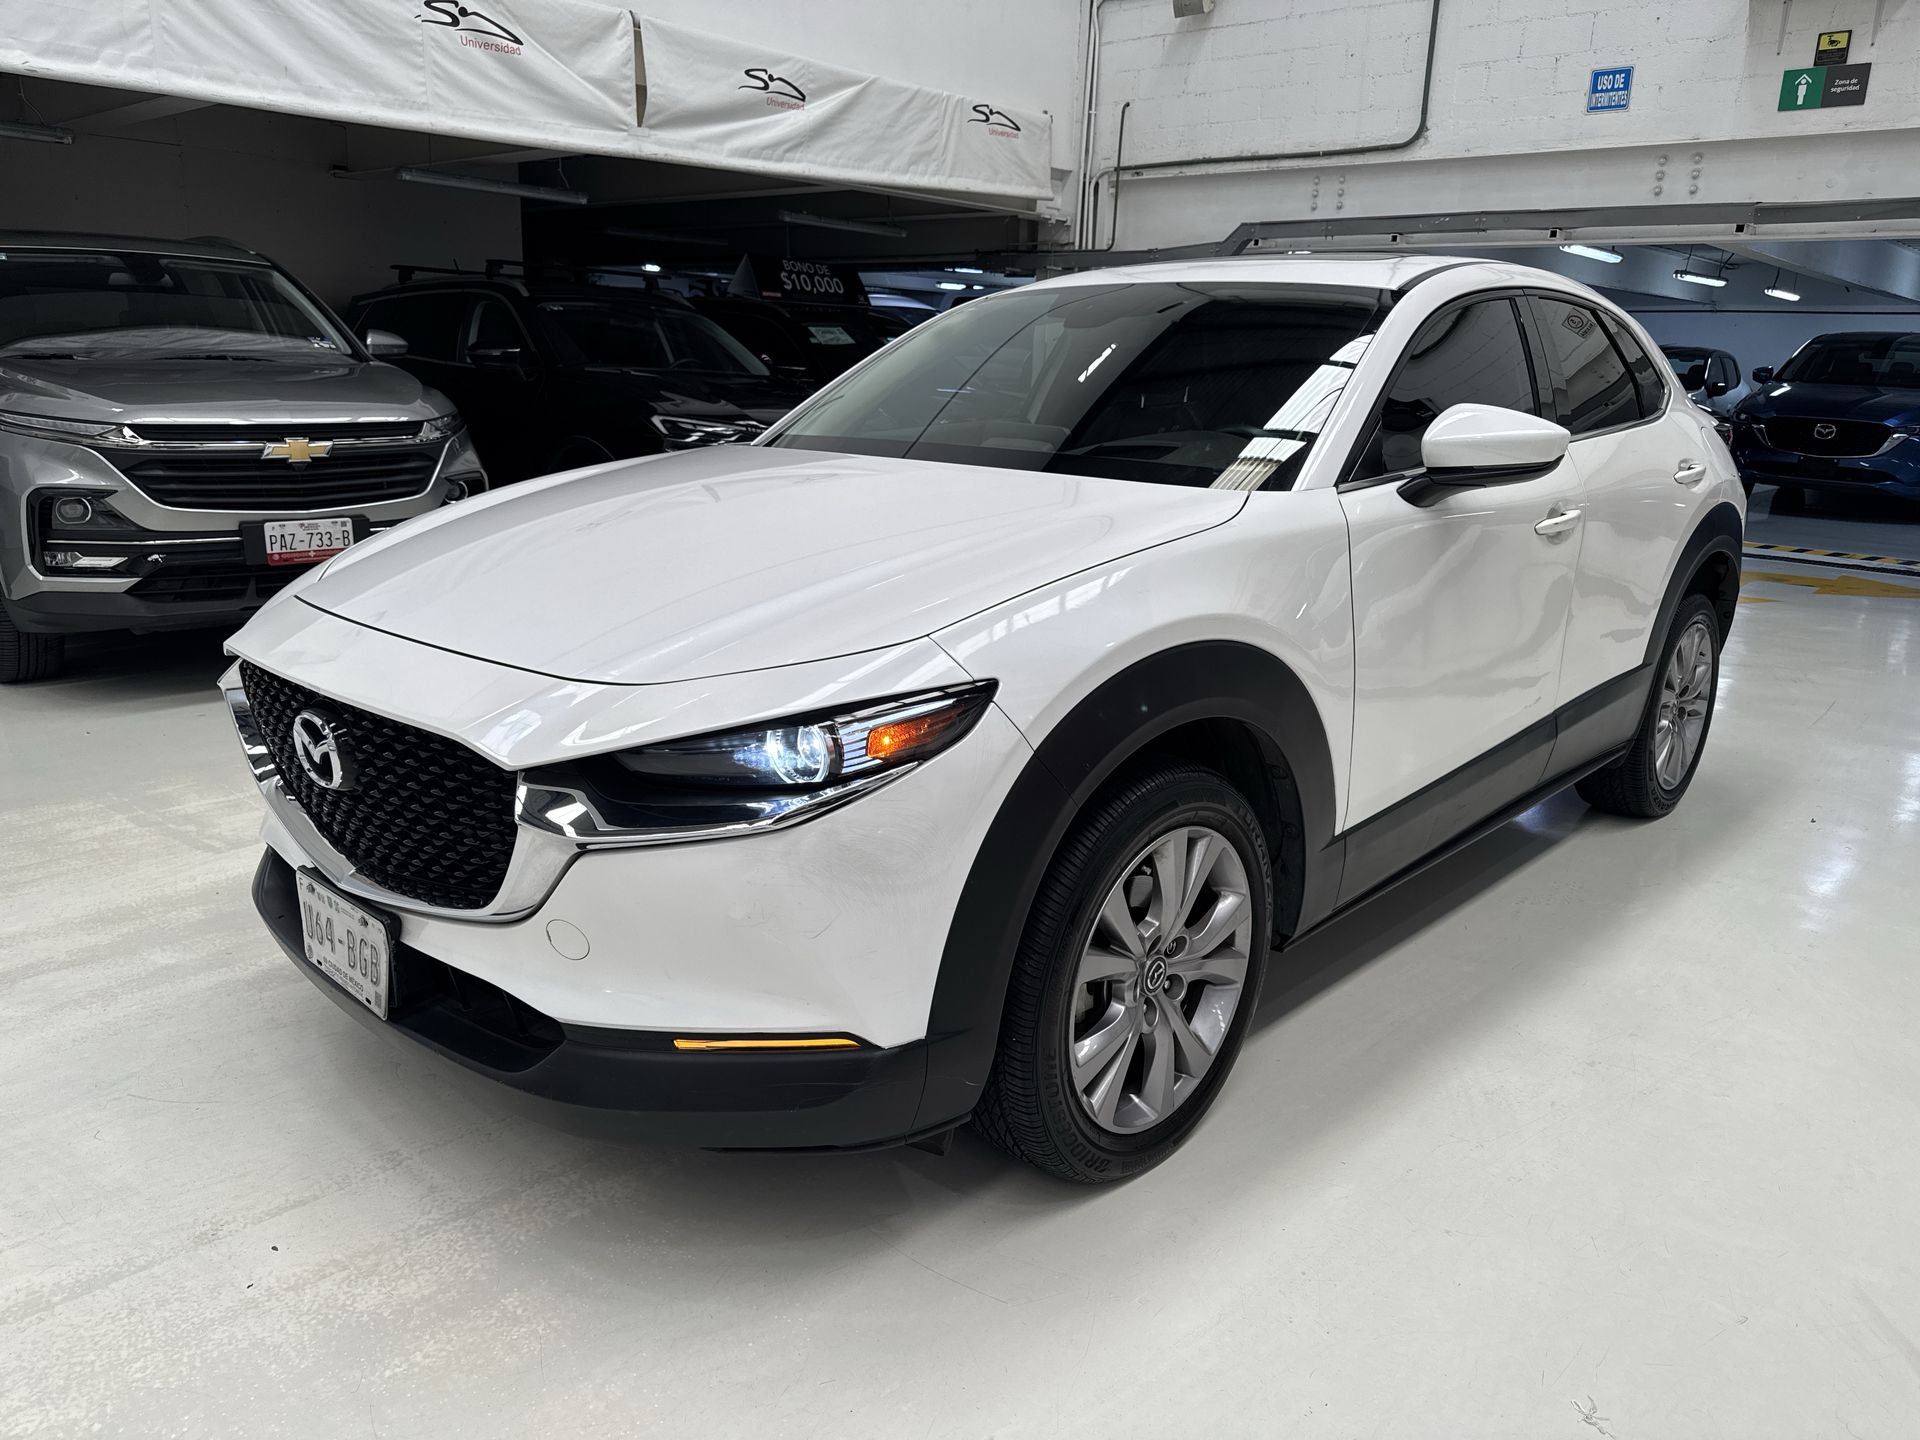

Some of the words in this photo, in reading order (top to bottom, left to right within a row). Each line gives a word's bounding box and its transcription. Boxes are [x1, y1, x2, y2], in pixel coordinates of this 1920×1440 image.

[460, 35, 522, 55] Universidad
[1597, 74, 1614, 90] USO
[1614, 73, 1626, 89] DE
[1830, 84, 1860, 93] seguridad
[767, 96, 805, 110] Universidad
[782, 259, 815, 274] BONO
[815, 264, 831, 276] DE
[780, 270, 844, 294] $10,000
[269, 529, 351, 552] PAZ-733-B
[303, 901, 381, 987] U64-BGB
[1042, 1046, 1113, 1174] BRIDGESTONE
